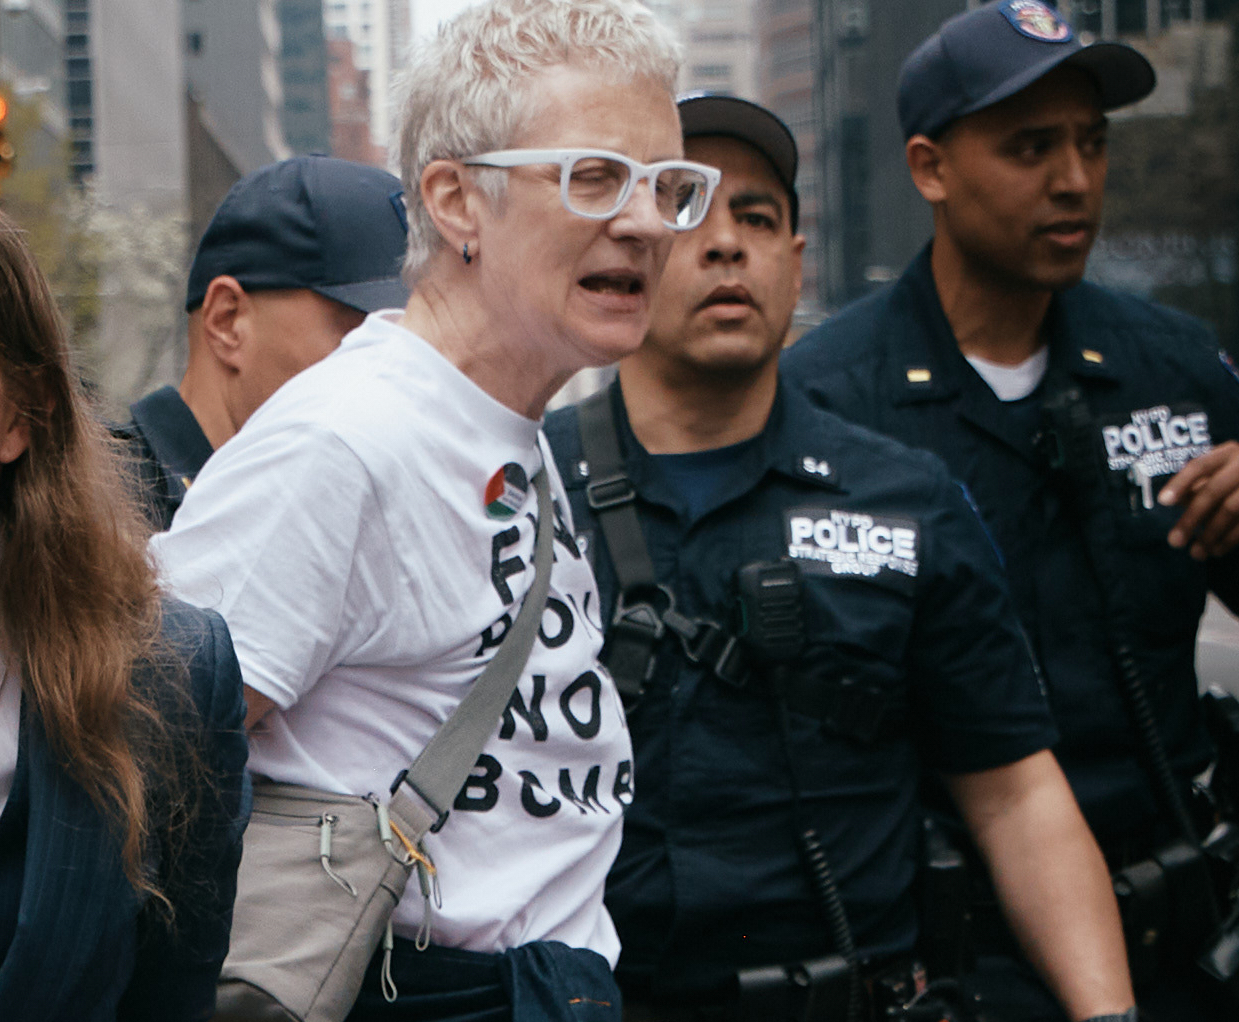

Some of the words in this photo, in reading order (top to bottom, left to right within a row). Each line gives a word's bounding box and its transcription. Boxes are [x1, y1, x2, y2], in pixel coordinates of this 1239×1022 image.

[1102, 411, 1211, 458] POLICE
[802, 456, 831, 477] S4
[790, 516, 917, 561] POLICE
